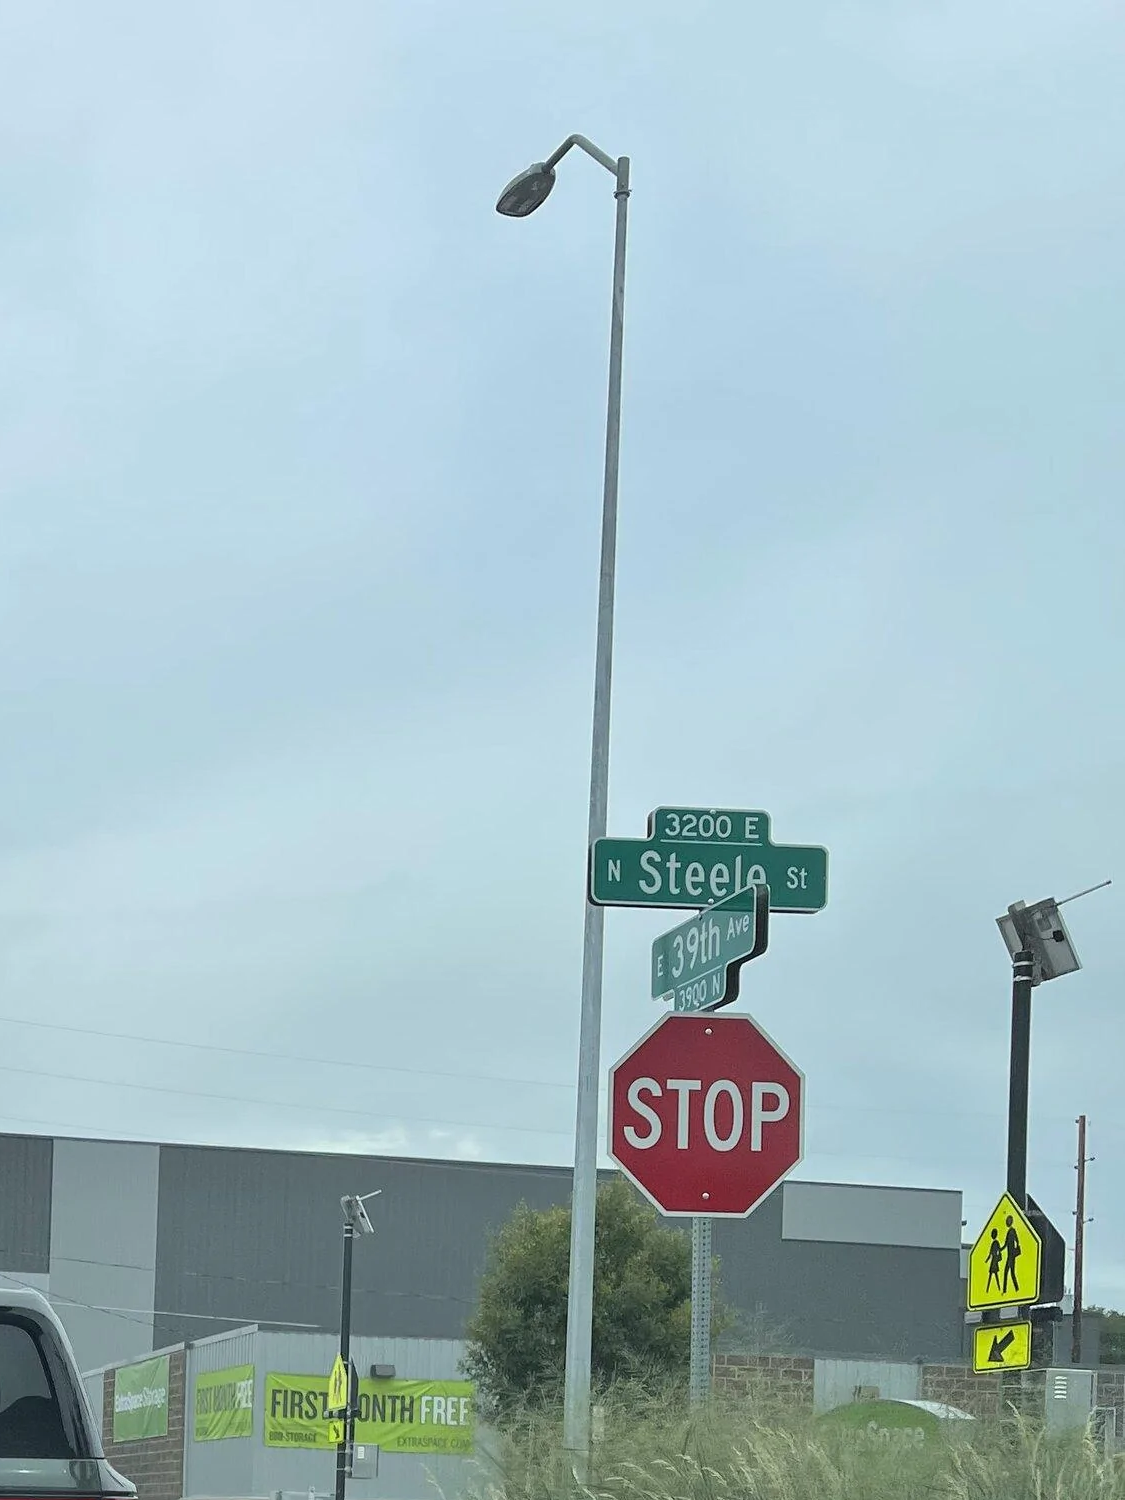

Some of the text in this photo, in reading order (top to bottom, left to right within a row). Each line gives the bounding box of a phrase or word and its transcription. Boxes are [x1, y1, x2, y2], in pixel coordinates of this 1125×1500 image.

[665, 814, 759, 838] 3200 E
[608, 850, 808, 896] N Steele St
[657, 914, 750, 978] E 39th Ave
[679, 973, 721, 1012] 3900 N
[623, 1077, 790, 1152] STOP
[271, 1389, 471, 1426] FIRST ONTH FREE
